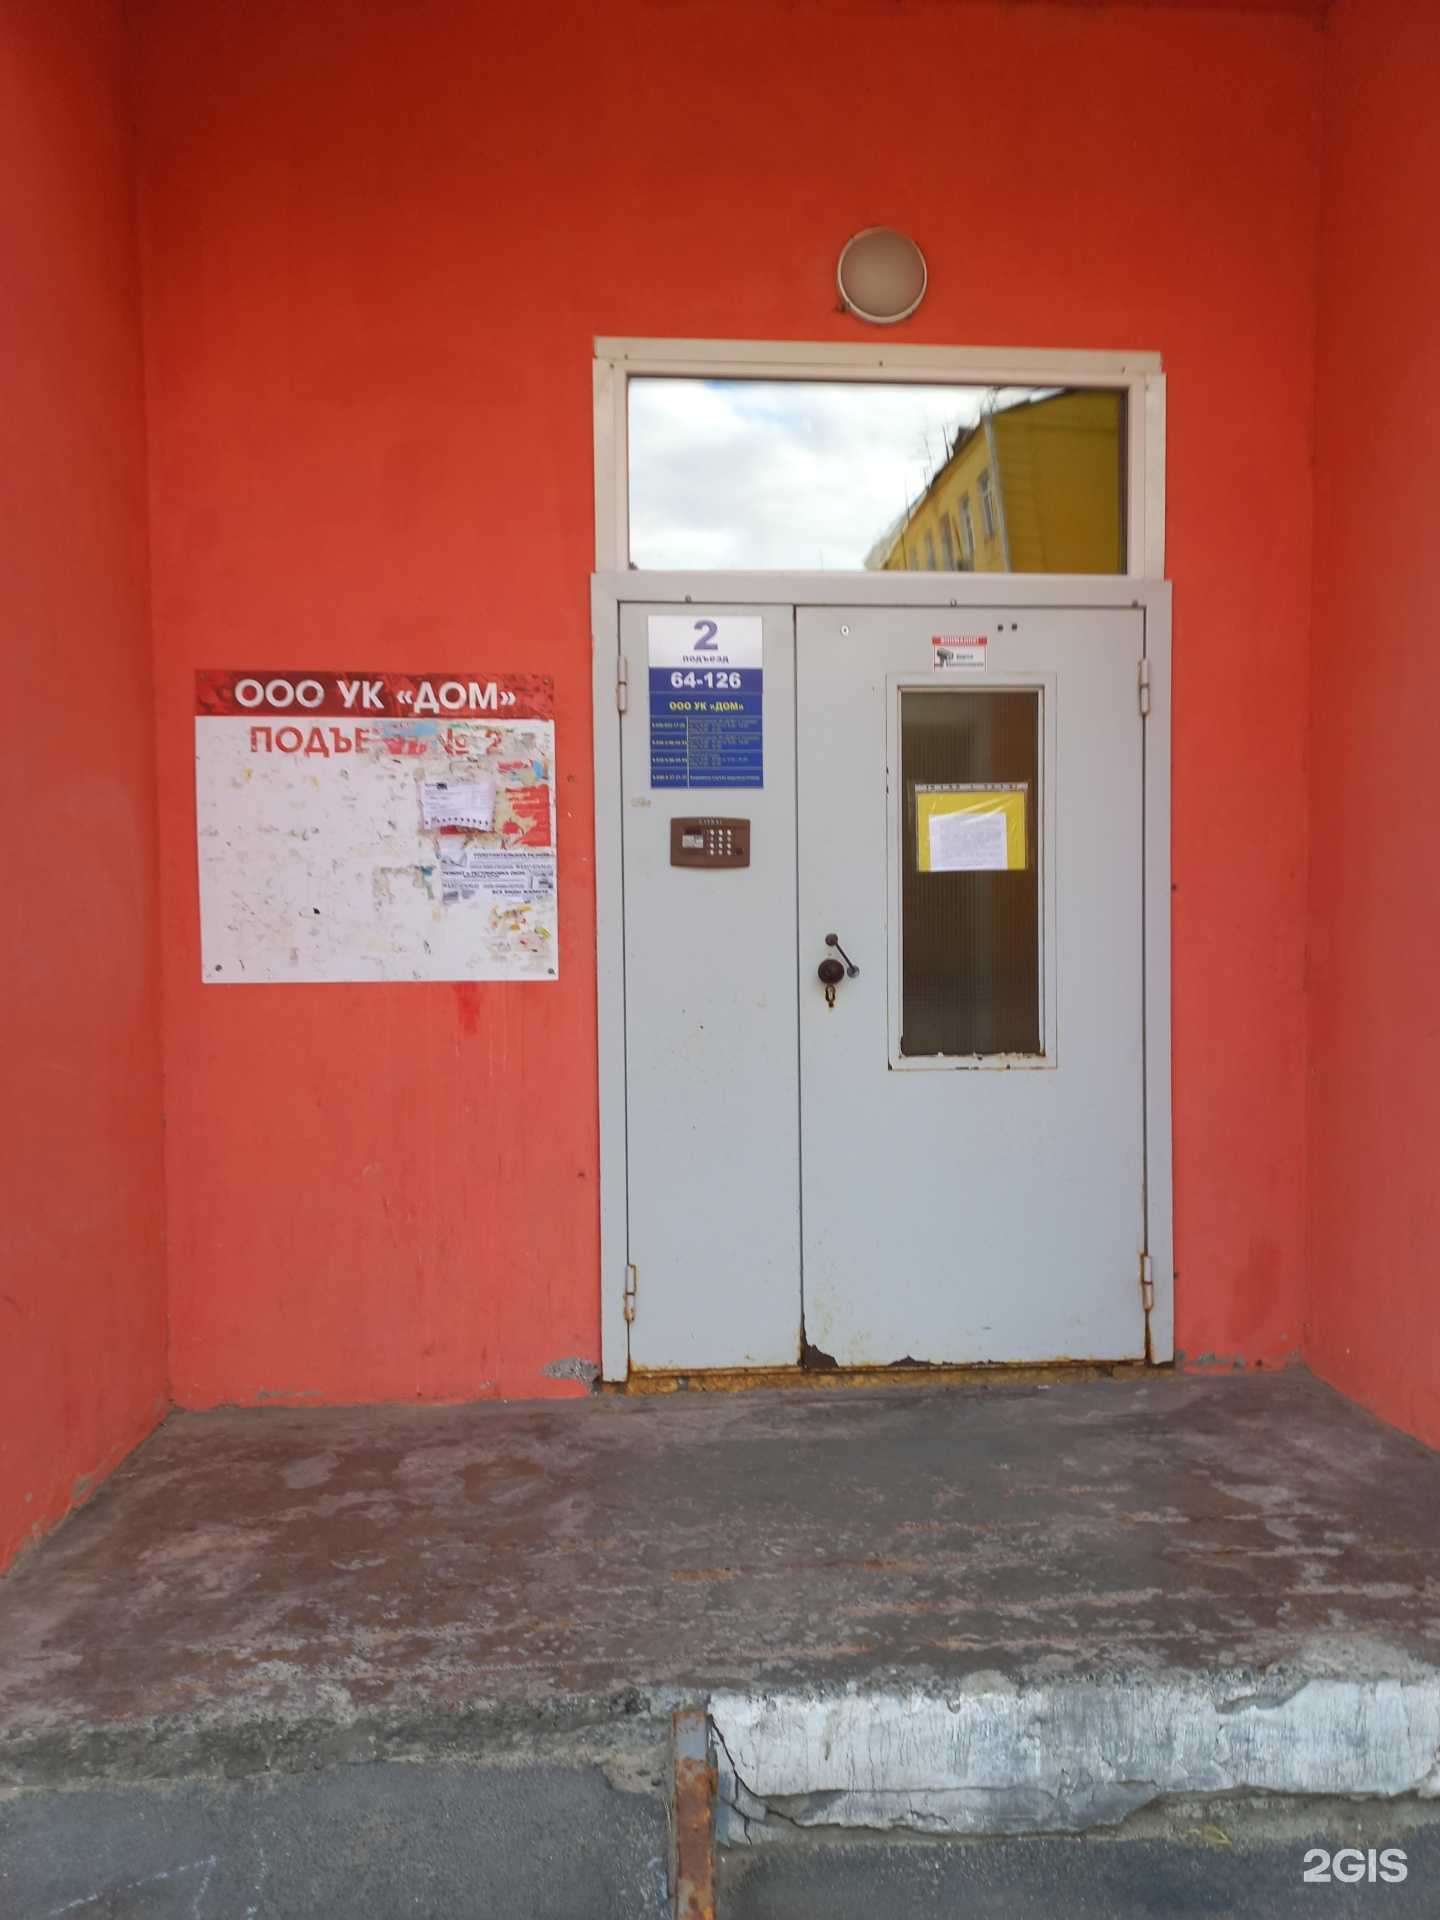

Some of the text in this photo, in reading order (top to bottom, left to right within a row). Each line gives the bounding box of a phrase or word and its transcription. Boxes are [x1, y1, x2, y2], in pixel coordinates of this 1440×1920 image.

[693, 619, 719, 650] 2
[670, 671, 742, 689] 64-126
[234, 678, 517, 714] ООО УК «ДОМ»
[669, 701, 692, 711] ООО
[694, 701, 707, 711] УК
[250, 725, 427, 758] ПОДЪЕ
